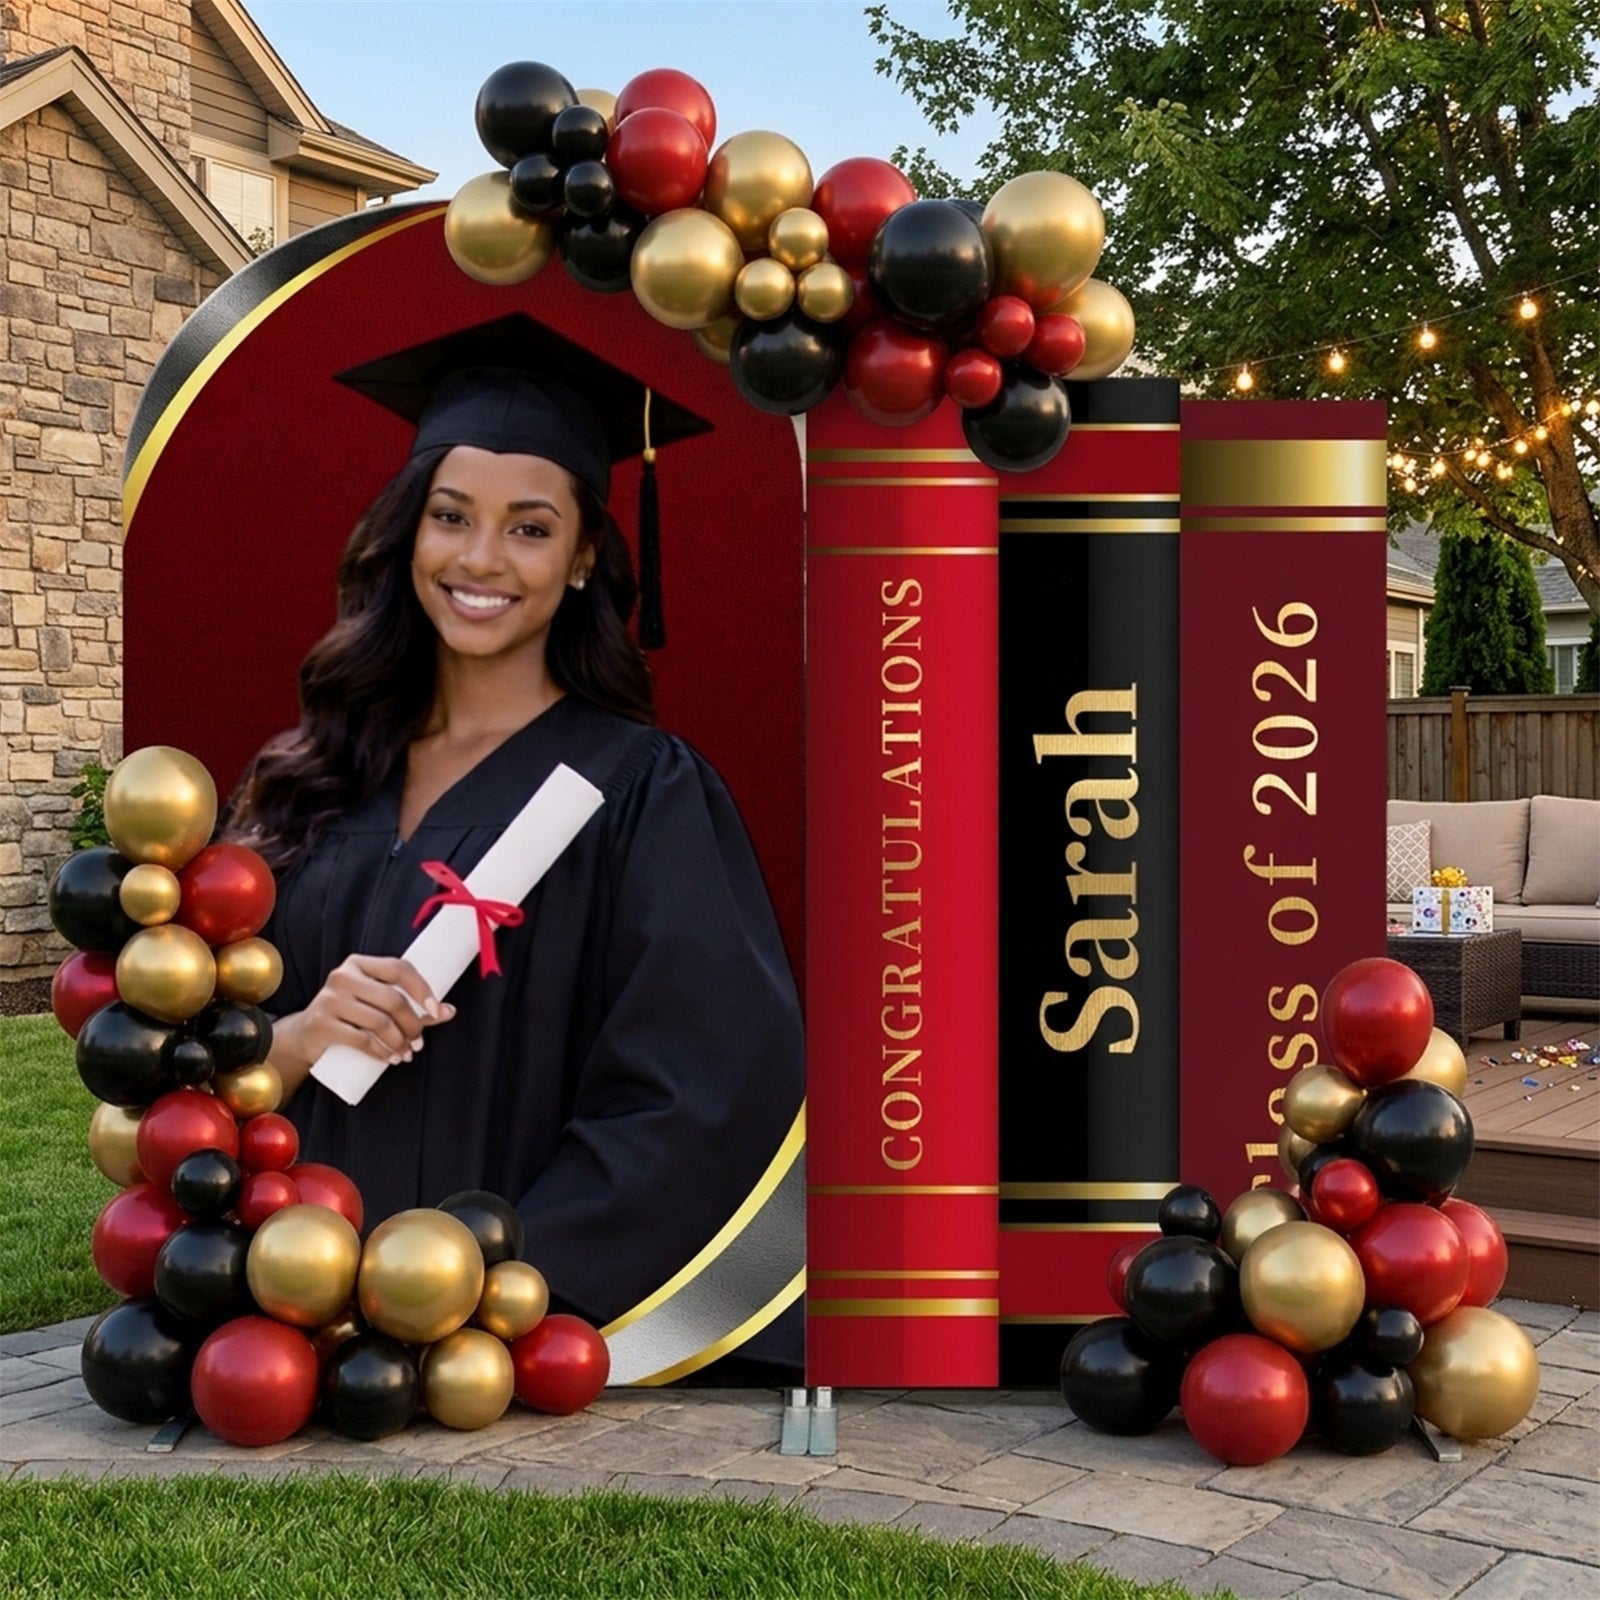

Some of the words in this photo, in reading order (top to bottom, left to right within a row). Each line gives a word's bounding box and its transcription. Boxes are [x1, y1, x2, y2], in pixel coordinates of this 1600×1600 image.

[1251, 601, 1319, 816] 2026
[880, 578, 923, 1171] CONGRATULATIONS
[1032, 682, 1140, 1054] Sarah
[1243, 844, 1319, 946] of
